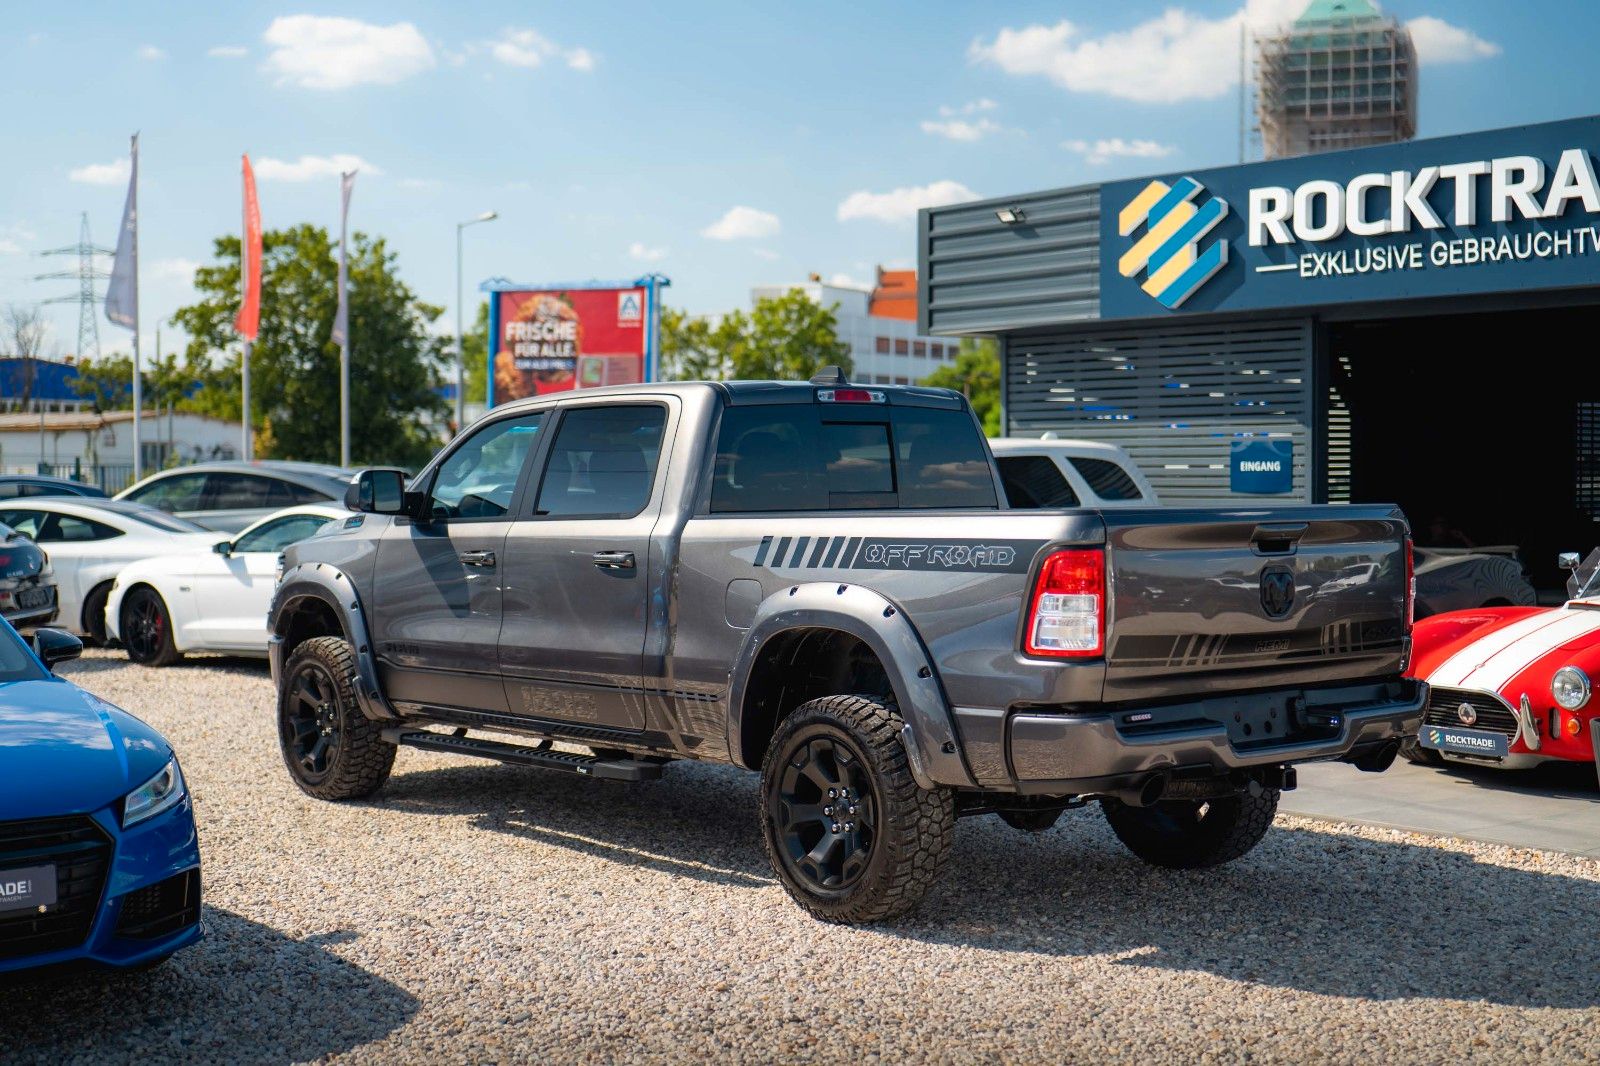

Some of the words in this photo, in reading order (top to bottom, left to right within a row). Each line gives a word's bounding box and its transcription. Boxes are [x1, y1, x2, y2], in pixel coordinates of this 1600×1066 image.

[1249, 149, 1600, 247] ROCKTRA
[1300, 244, 1423, 277] EXKLUSIVE
[505, 321, 577, 341] FRISCHE
[1240, 461, 1281, 472] EINGANG
[865, 544, 929, 568] OFF
[926, 544, 1016, 568] ROAD
[1255, 639, 1290, 652] HEMI
[1445, 735, 1493, 747] ROCKTRADE
